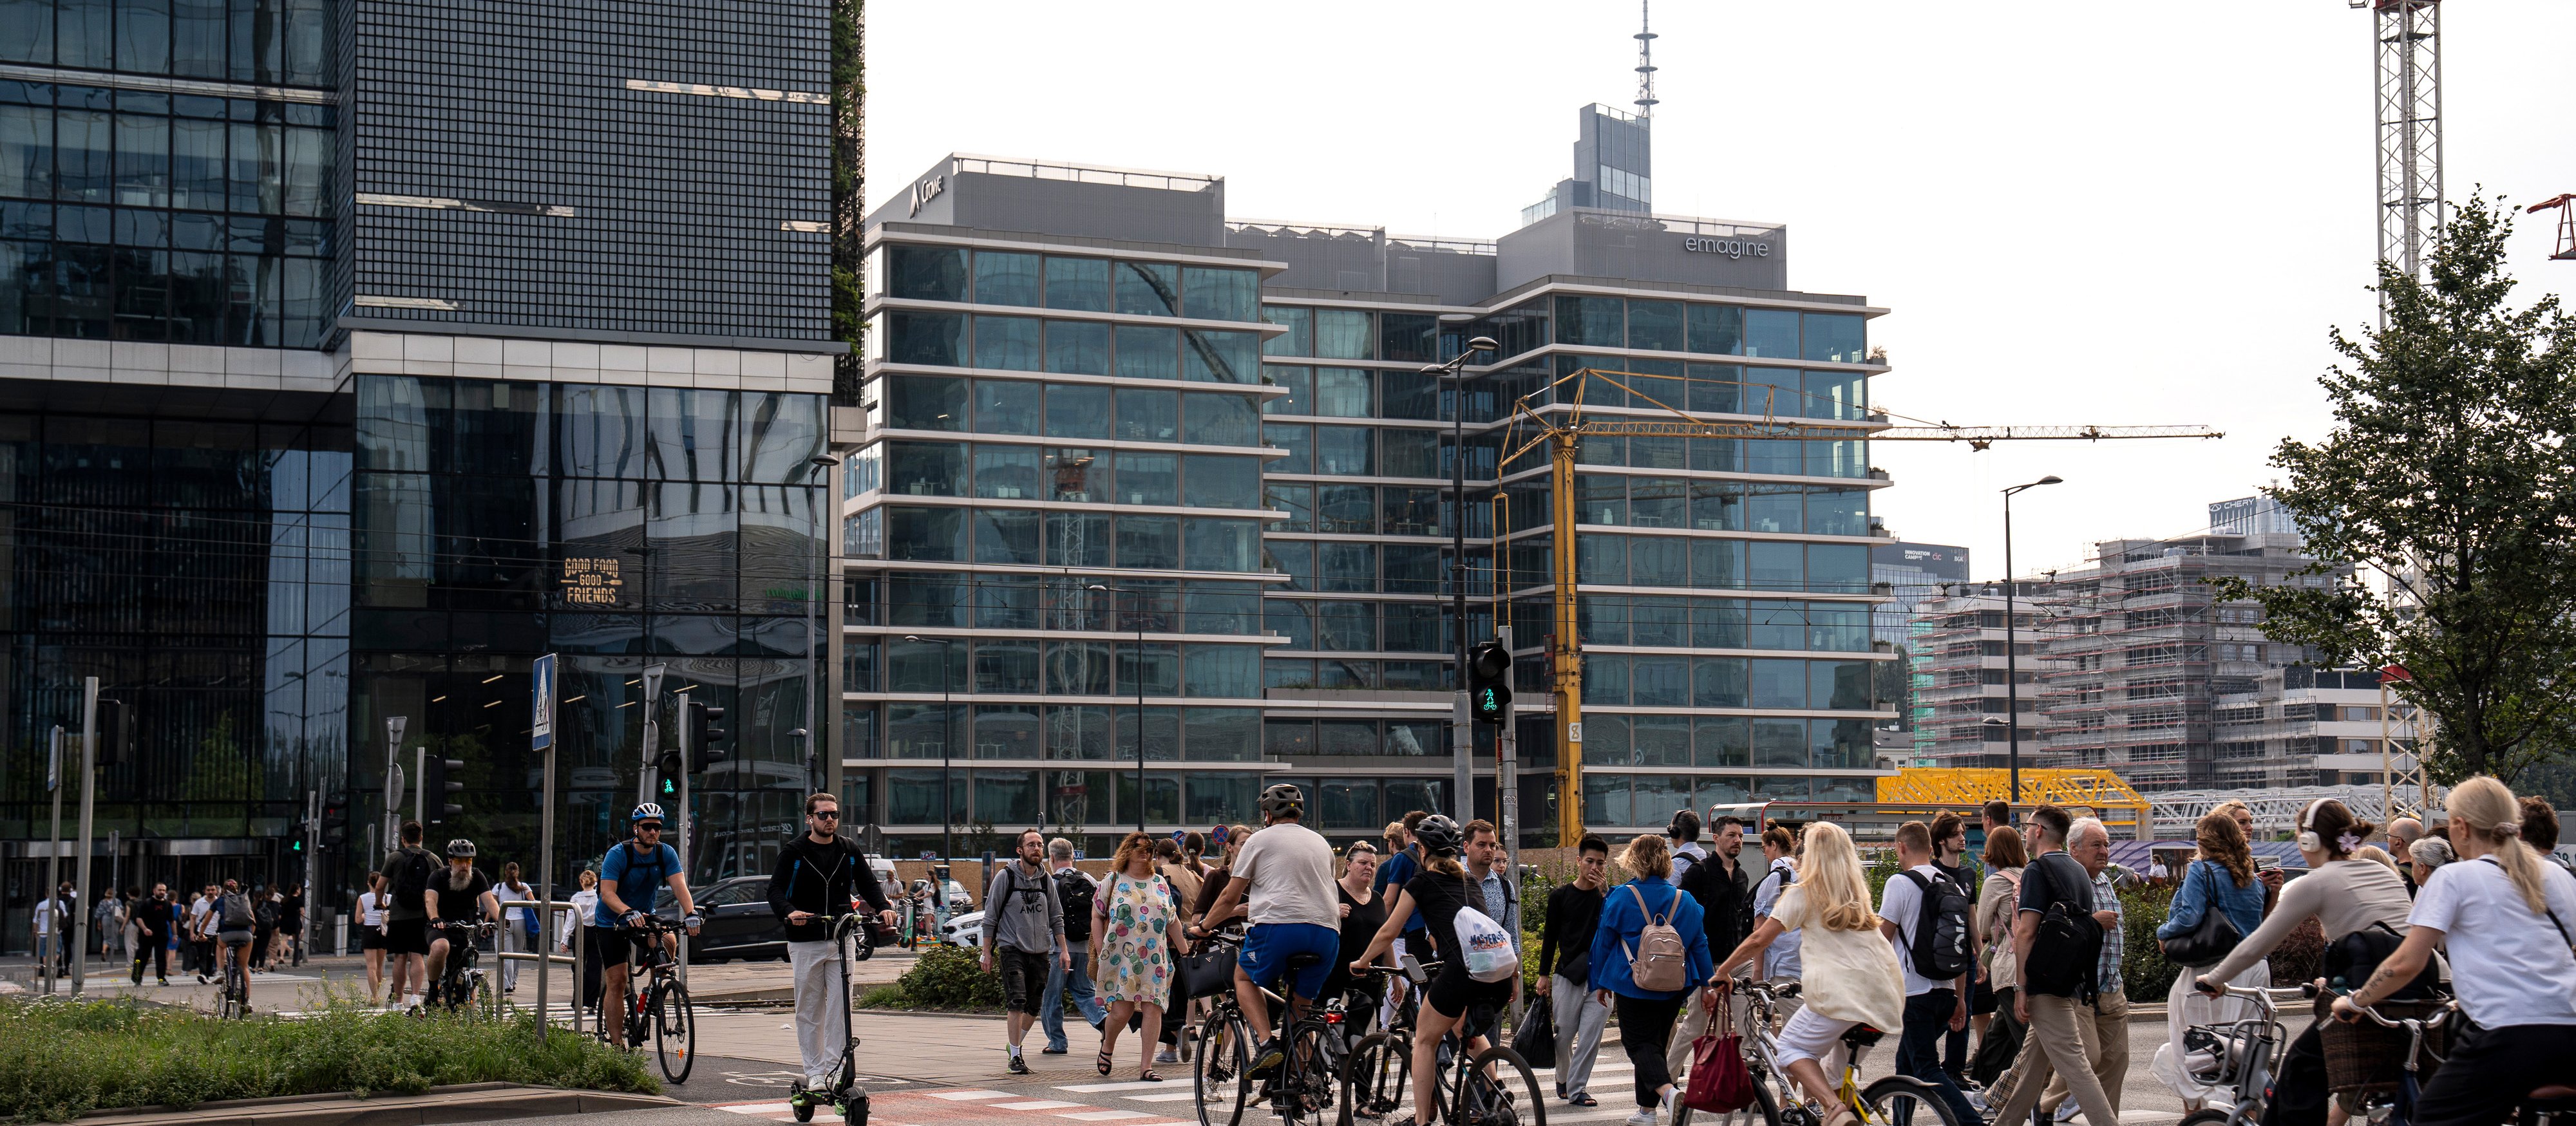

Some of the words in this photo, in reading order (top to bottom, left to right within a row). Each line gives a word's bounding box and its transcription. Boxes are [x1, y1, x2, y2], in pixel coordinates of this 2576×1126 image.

[922, 175, 942, 203] Crowe
[1685, 238, 1768, 259] emagine
[2224, 498, 2255, 509] CHERY
[565, 558, 591, 577] GOOD
[593, 558, 618, 578] FOOD
[580, 574, 601, 586] GOOD
[567, 586, 616, 603] FRIENDS
[1571, 725, 1579, 740] 8
[1020, 904, 1043, 914] AMC
